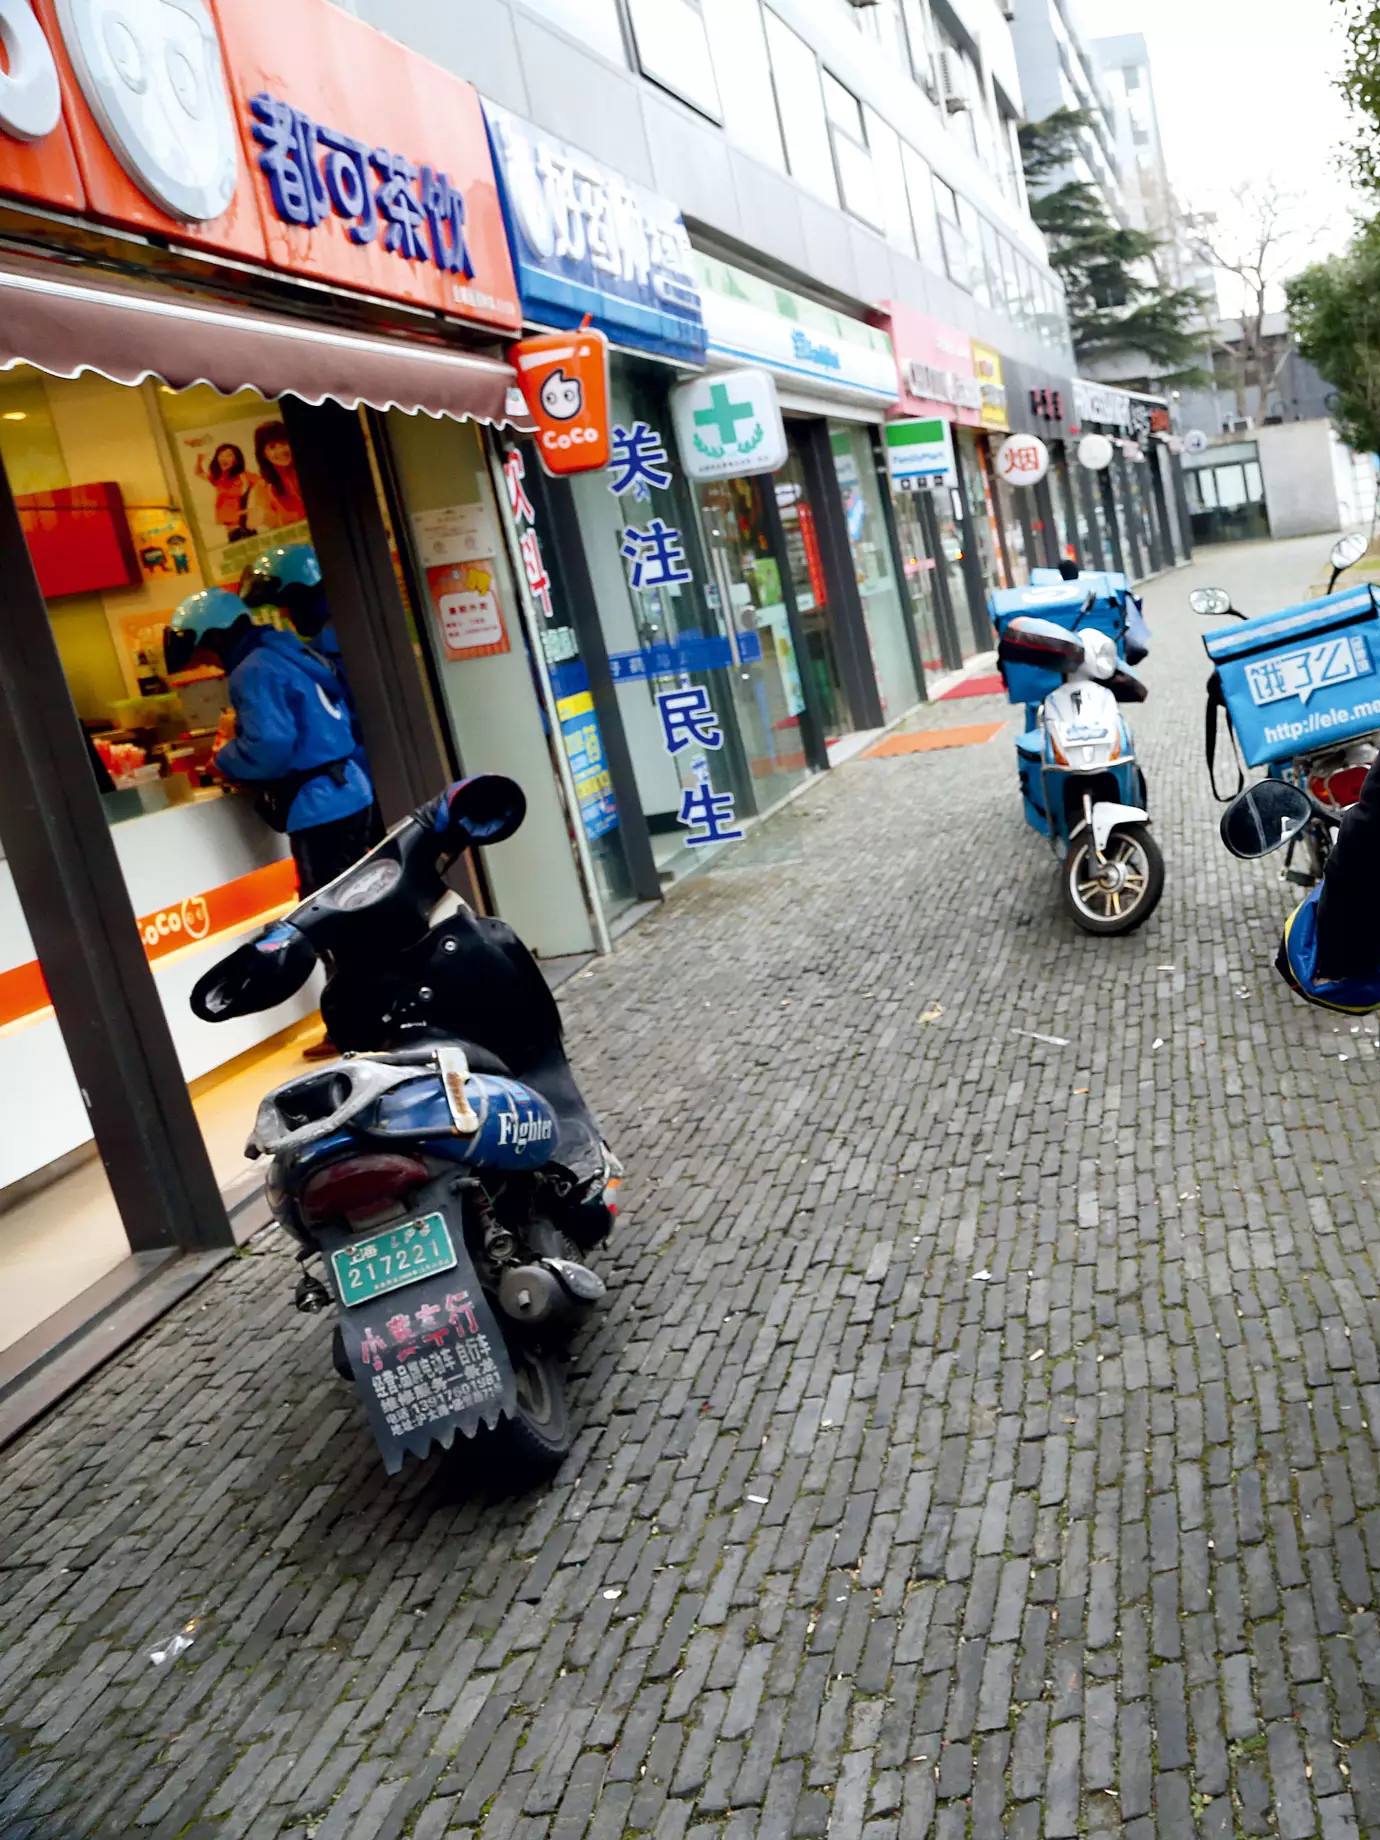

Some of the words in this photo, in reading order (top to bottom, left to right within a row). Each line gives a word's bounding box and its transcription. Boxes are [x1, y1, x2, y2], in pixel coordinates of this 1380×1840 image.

[250, 92, 475, 280] 都可茶饮
[543, 427, 599, 449] CoCo
[1003, 445, 1040, 474] 烟
[137, 911, 182, 946] oCo
[497, 1110, 552, 1155] Fighter
[348, 1239, 440, 1289] 217221
